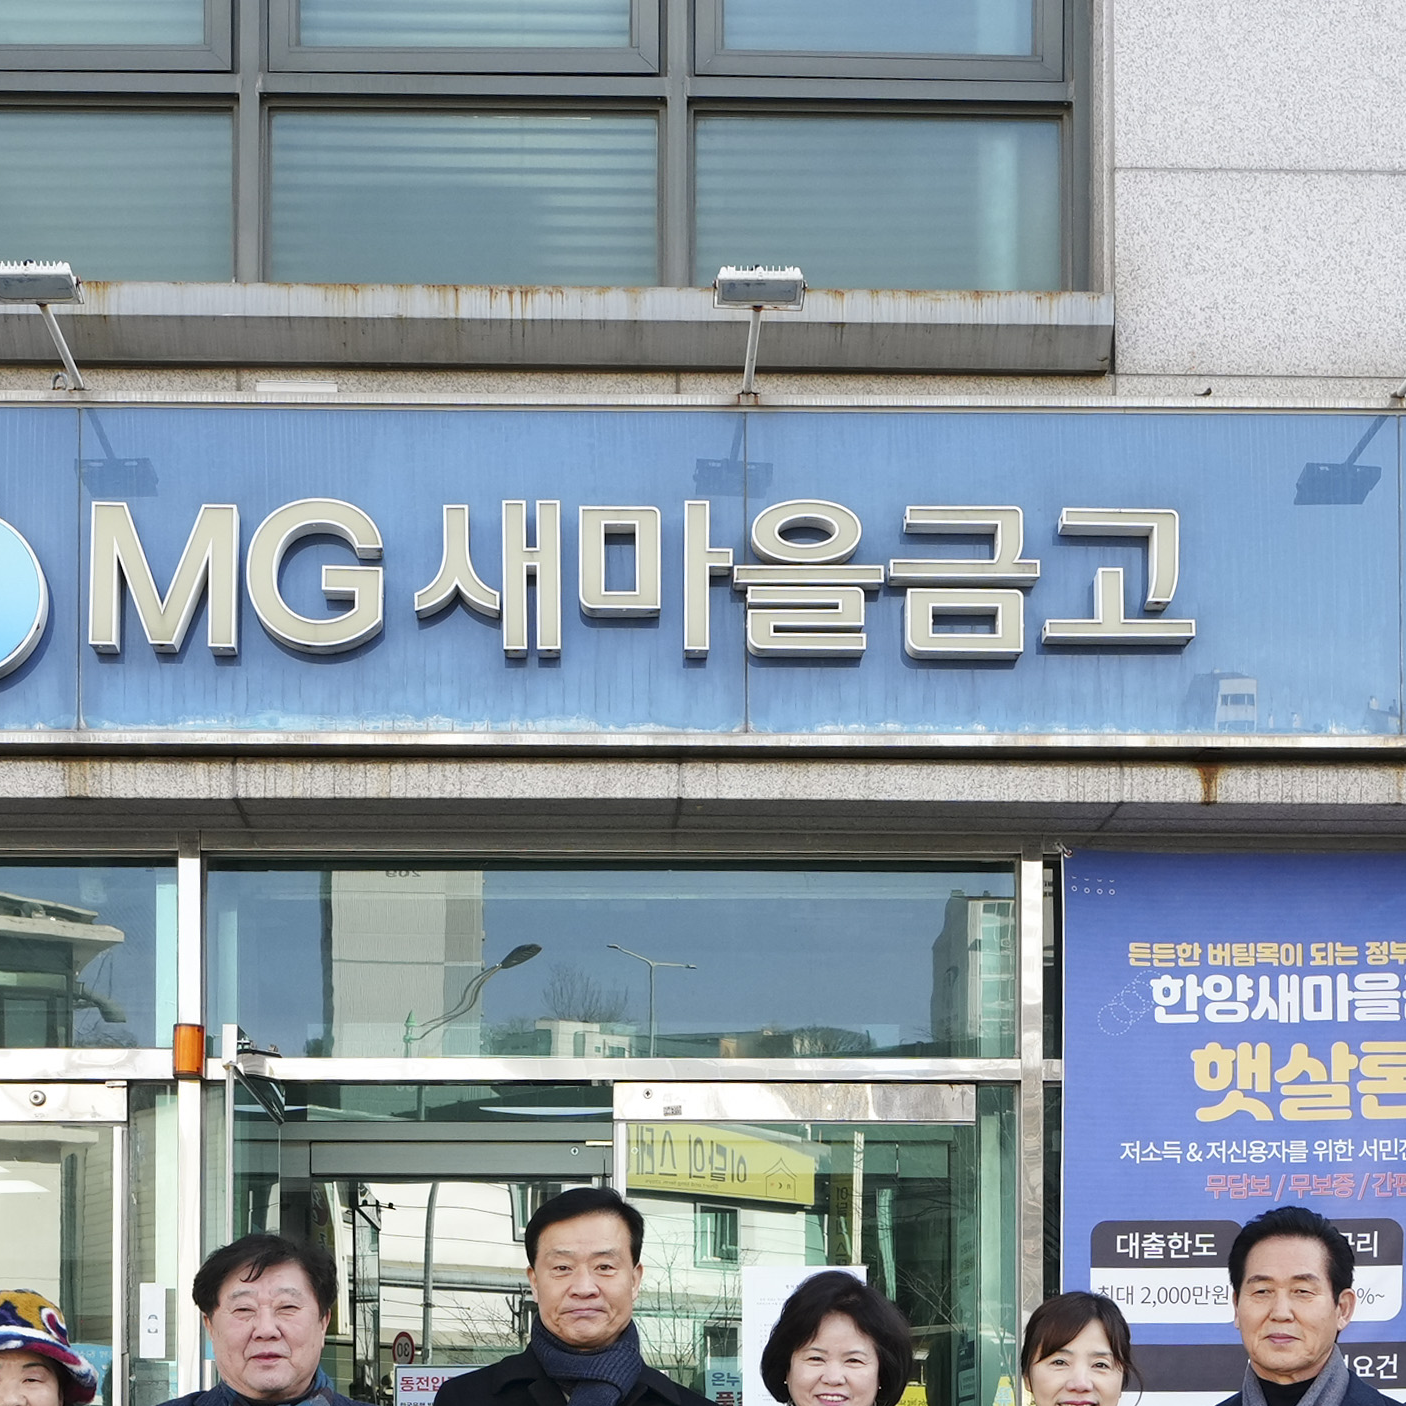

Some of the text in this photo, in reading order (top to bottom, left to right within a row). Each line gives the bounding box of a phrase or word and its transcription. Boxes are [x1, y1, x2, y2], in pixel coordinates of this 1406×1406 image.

[1128, 941, 1202, 967] 든든한
[1207, 942, 1303, 967] 버팀목이
[1310, 942, 1358, 966] 되는
[1120, 1140, 1183, 1165] 저소득
[1187, 1142, 1203, 1163] &
[1206, 1140, 1309, 1165] 저신용자를
[1312, 1139, 1355, 1163] 위한
[1205, 1173, 1272, 1199] 무담보
[1289, 1173, 1354, 1199] 무보증
[1115, 1232, 1218, 1259] 대출한도
[1140, 1284, 1230, 1306] 2,000만원
